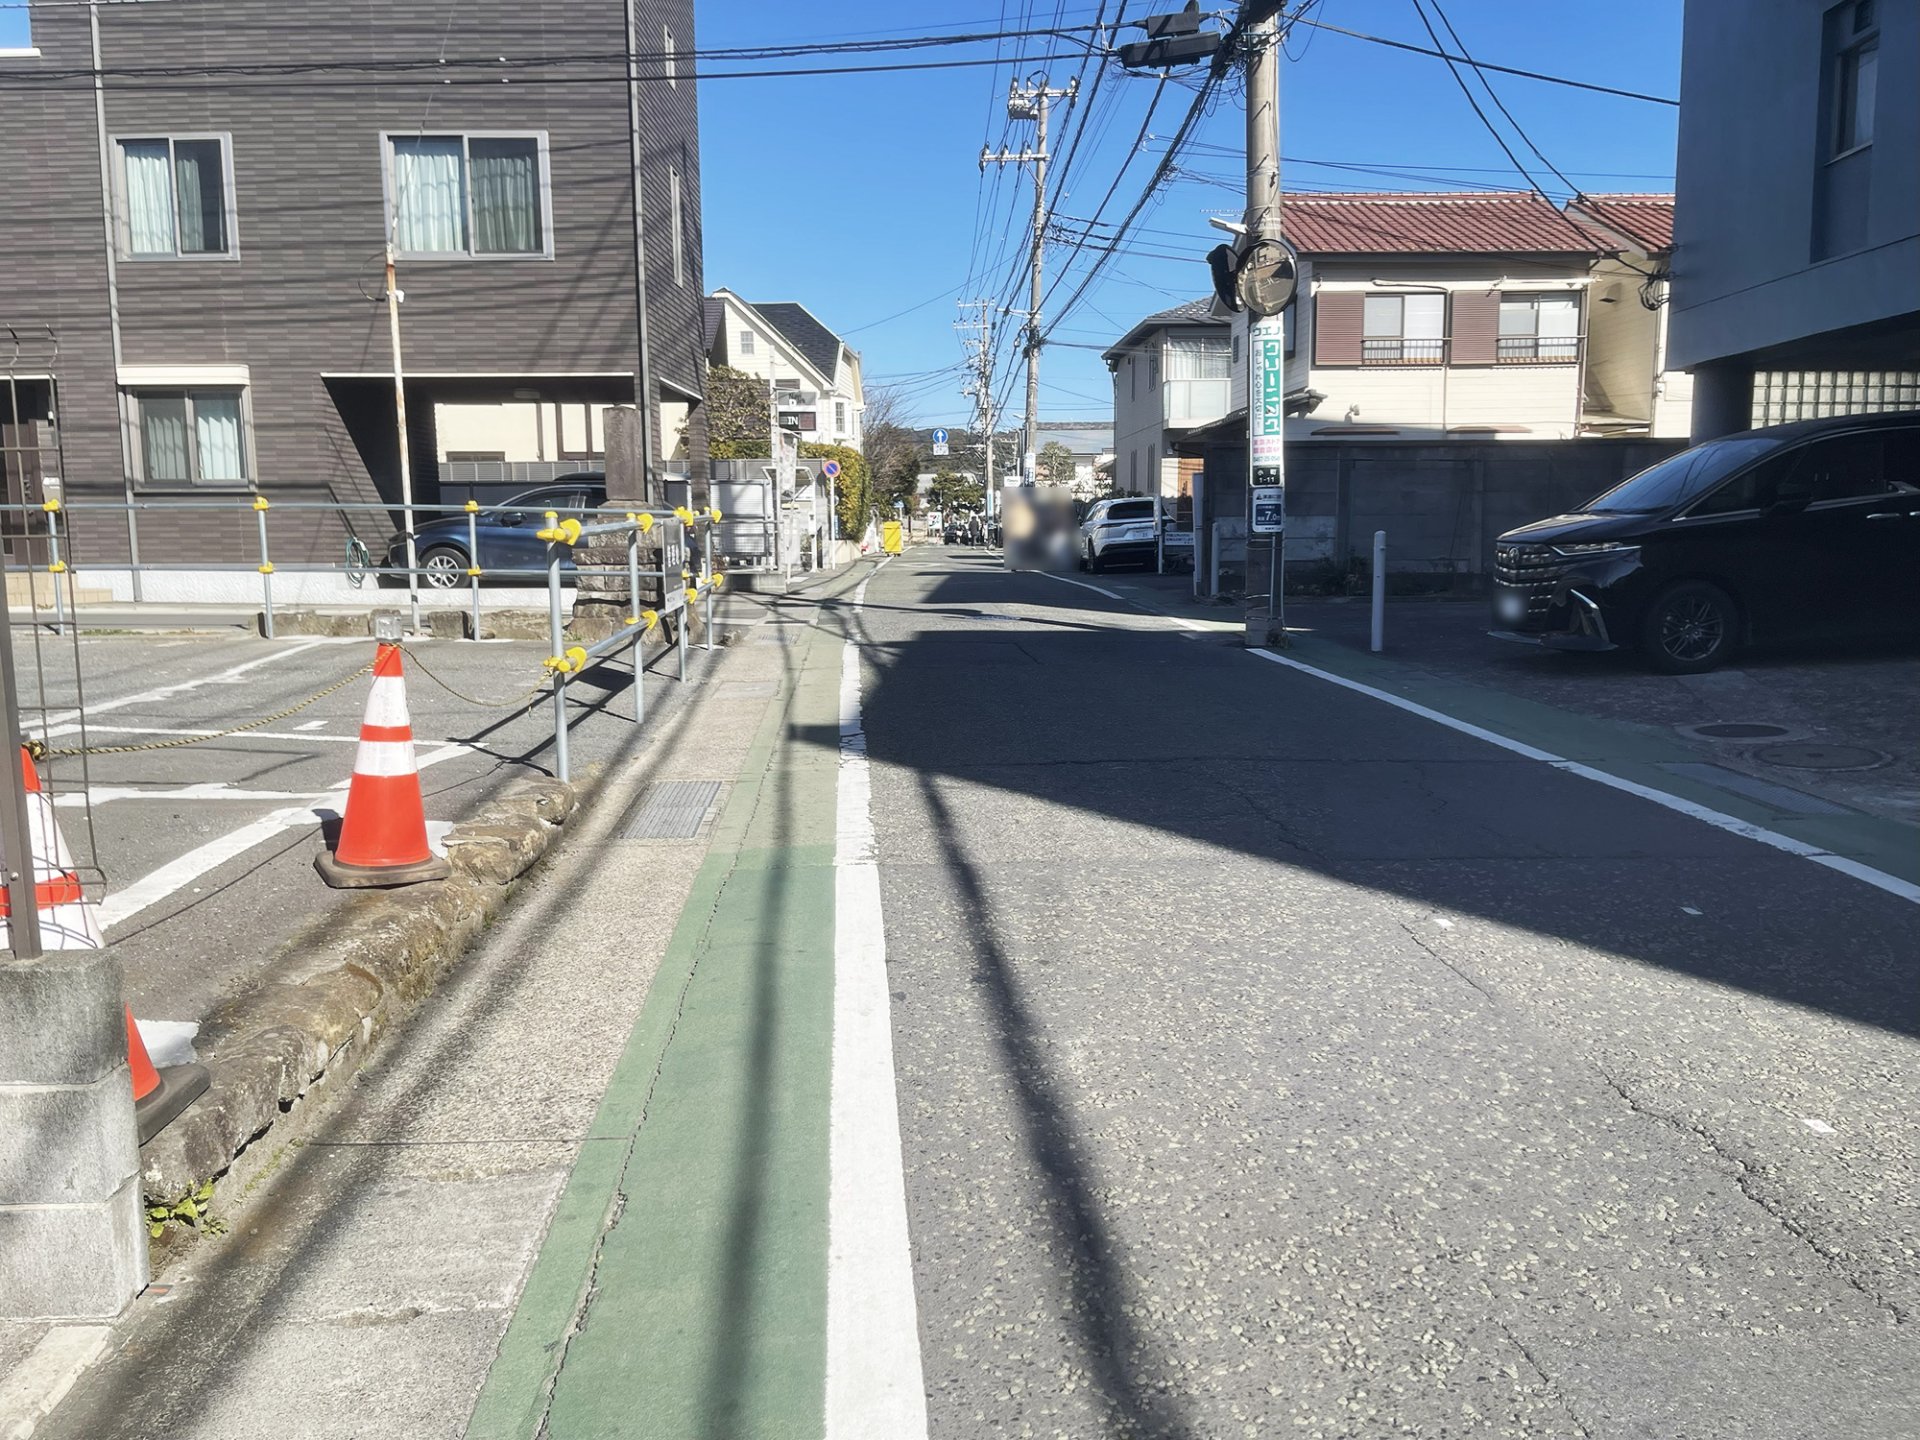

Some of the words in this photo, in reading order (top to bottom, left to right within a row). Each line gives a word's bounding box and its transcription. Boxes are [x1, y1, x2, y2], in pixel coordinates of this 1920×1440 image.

[1252, 326, 1281, 337] ウエノ
[1265, 342, 1280, 433] クリーニング
[787, 416, 799, 425] IN
